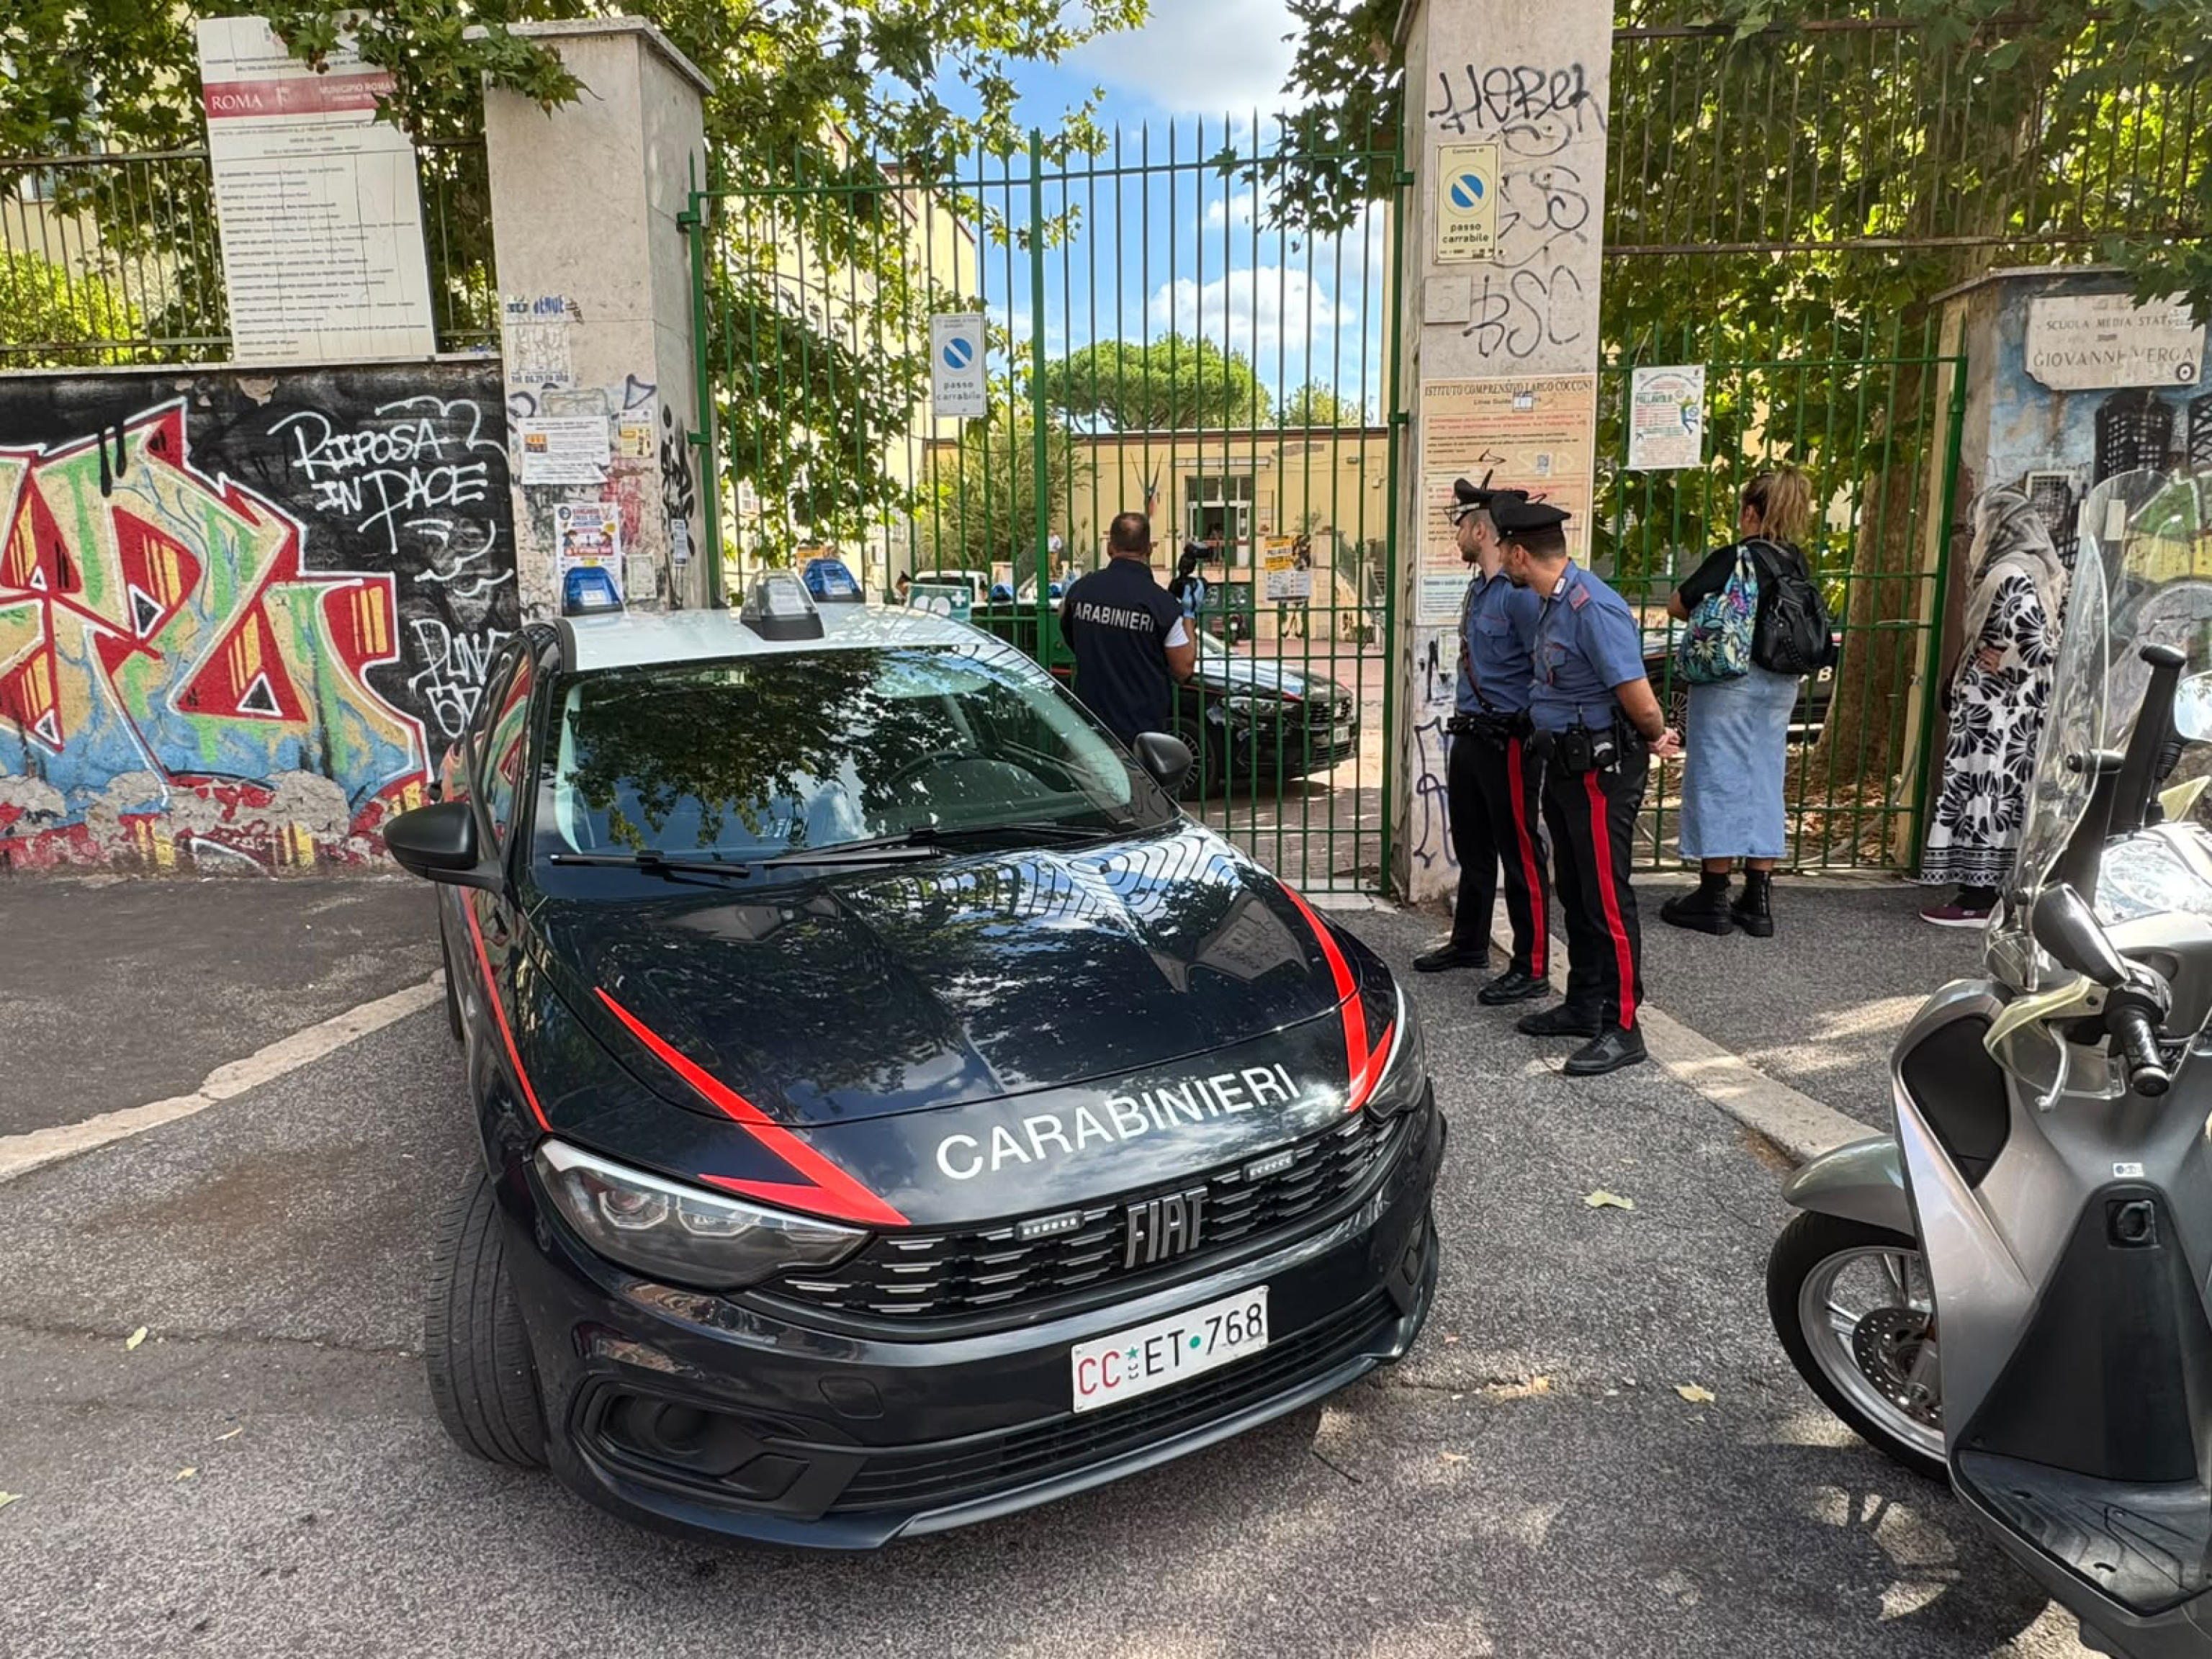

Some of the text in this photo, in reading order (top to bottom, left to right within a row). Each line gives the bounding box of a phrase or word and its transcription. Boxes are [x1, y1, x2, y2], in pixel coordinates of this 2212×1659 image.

[212, 94, 263, 110] ROMA
[1450, 223, 1482, 233] passo
[1442, 233, 1489, 244] carrabile
[2046, 320, 2090, 331] SCUOLA
[2096, 318, 2131, 328] MEDIA
[2033, 346, 2195, 367] GIOVANNI VERGA
[943, 381, 974, 391] passo
[937, 392, 981, 400] carrabile
[311, 461, 489, 554] IN PACE
[936, 1062, 1301, 1181] CARABINIERI
[1125, 1186, 1209, 1269] FIAT
[1078, 1302, 1264, 1395] CC ET 768
